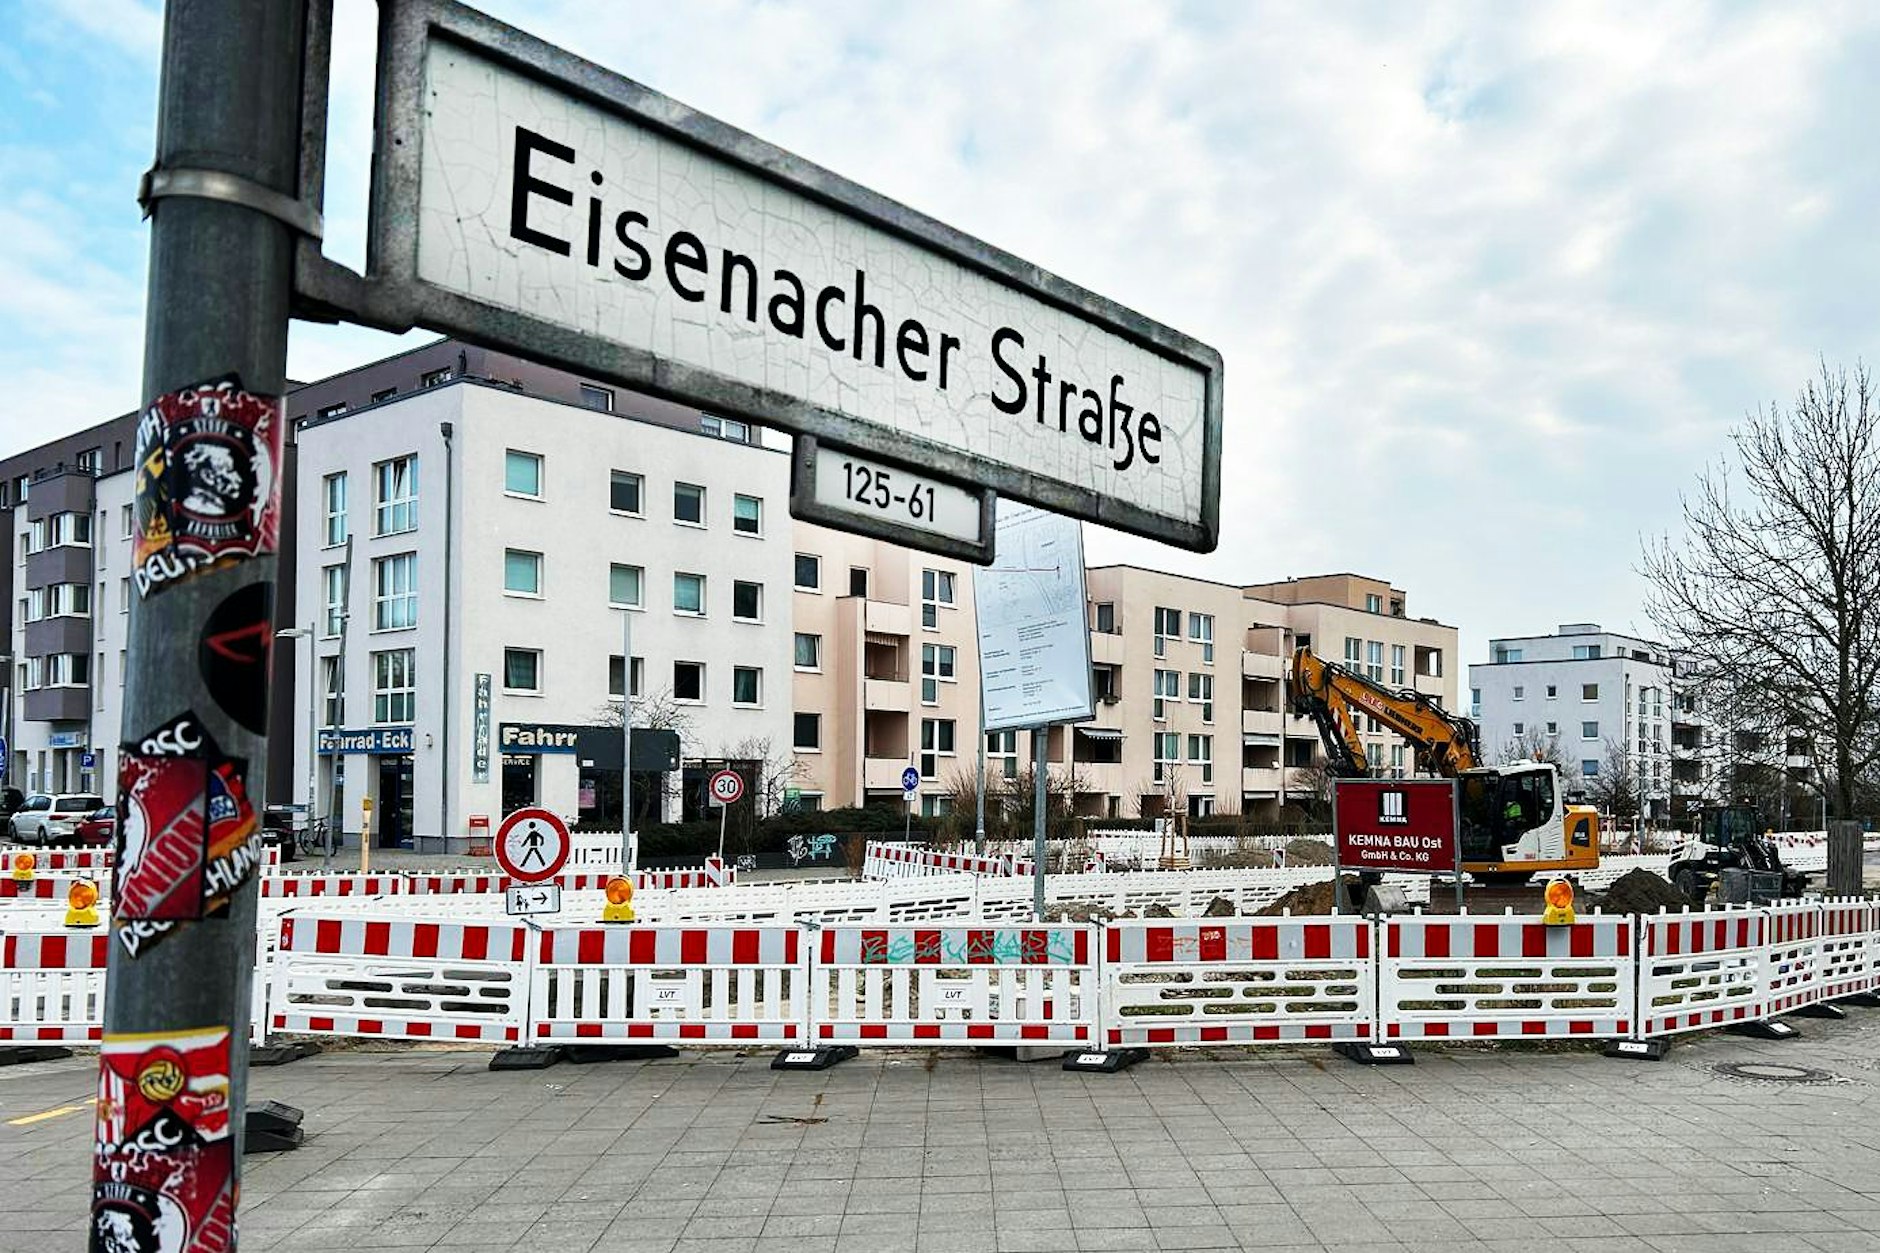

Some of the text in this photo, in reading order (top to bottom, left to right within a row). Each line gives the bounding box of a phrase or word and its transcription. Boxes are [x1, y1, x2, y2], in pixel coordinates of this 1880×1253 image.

[509, 125, 1163, 471] Eisenacher Straße
[843, 461, 935, 523] 125-61
[83, 755, 92, 766] P
[718, 779, 736, 794] 30
[1379, 815, 1408, 824] KEMNA
[1348, 833, 1443, 849] KEMNA BAU Ost
[1361, 849, 1430, 862] GmbH & Co. KG
[659, 990, 676, 999] LVT
[945, 990, 963, 999] LVT
